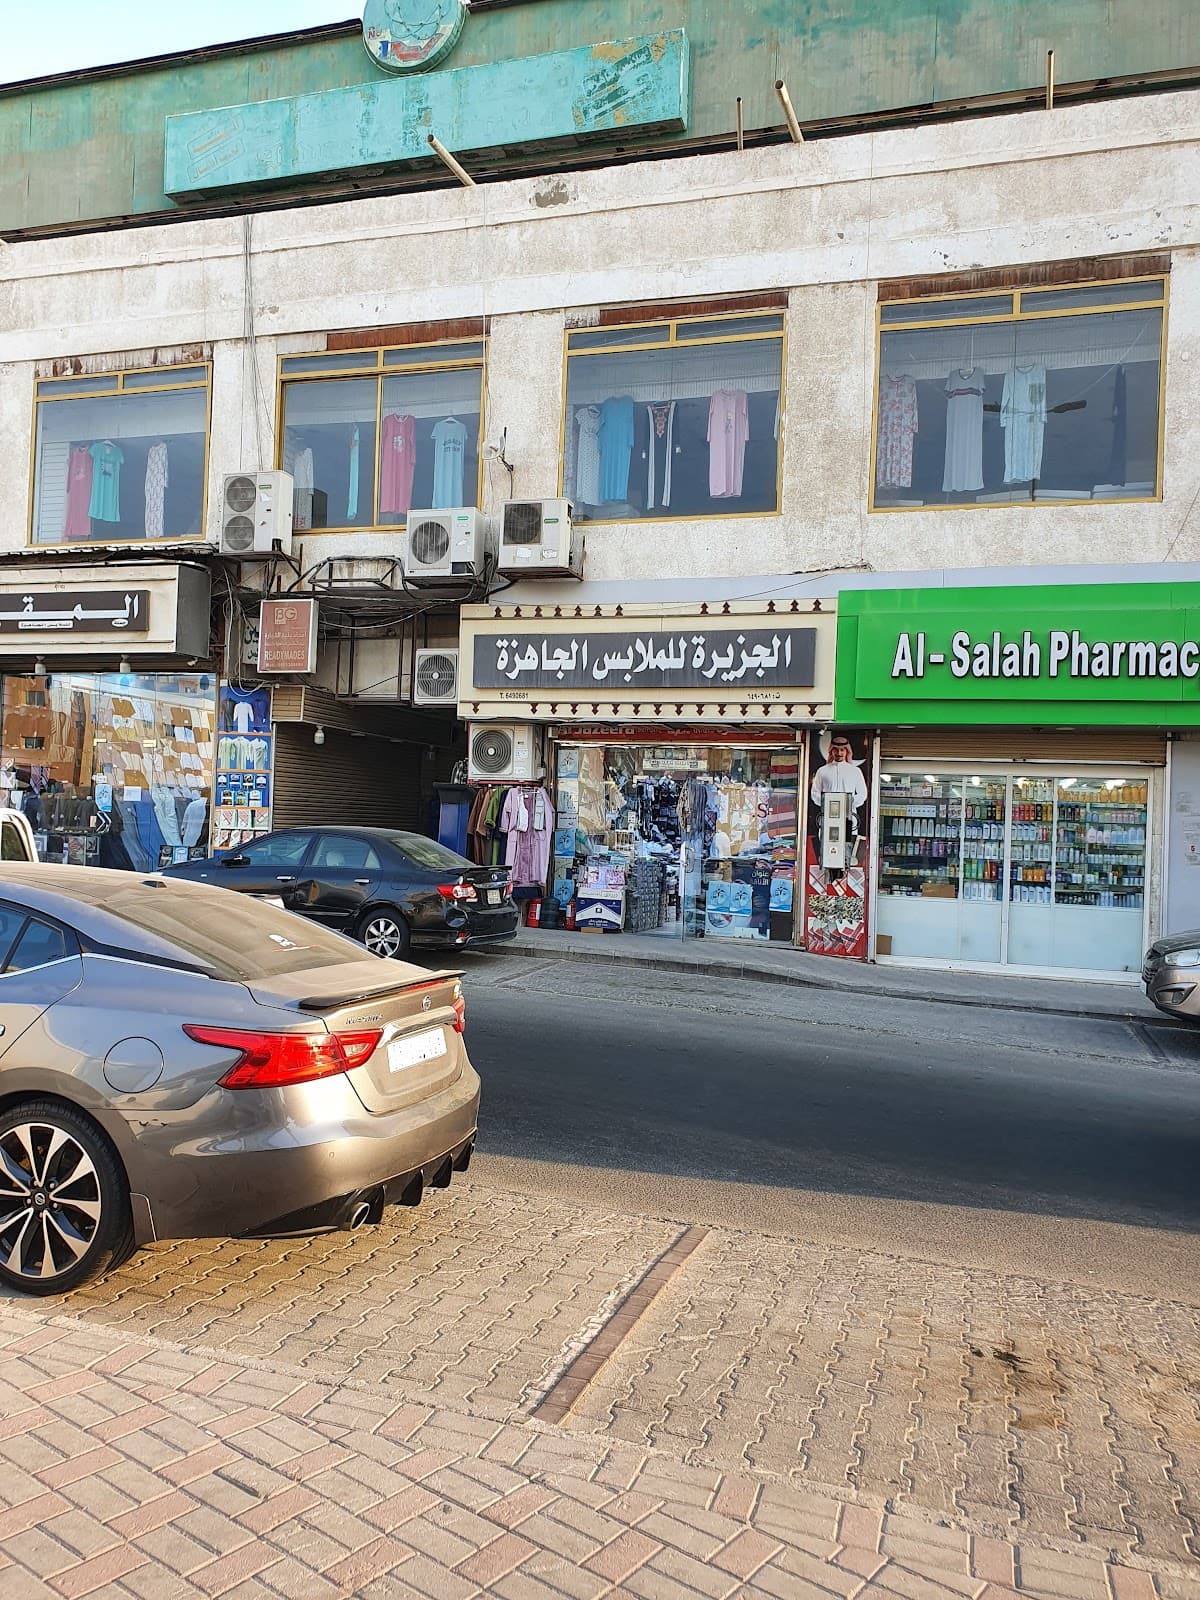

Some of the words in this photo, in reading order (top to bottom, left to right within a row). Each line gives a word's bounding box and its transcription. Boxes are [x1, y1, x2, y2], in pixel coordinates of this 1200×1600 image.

[495, 637, 588, 681] الجاهزة
[592, 636, 687, 682] للملابس
[691, 633, 792, 682] الجزيرة
[1048, 629, 1200, 679] Pharmac
